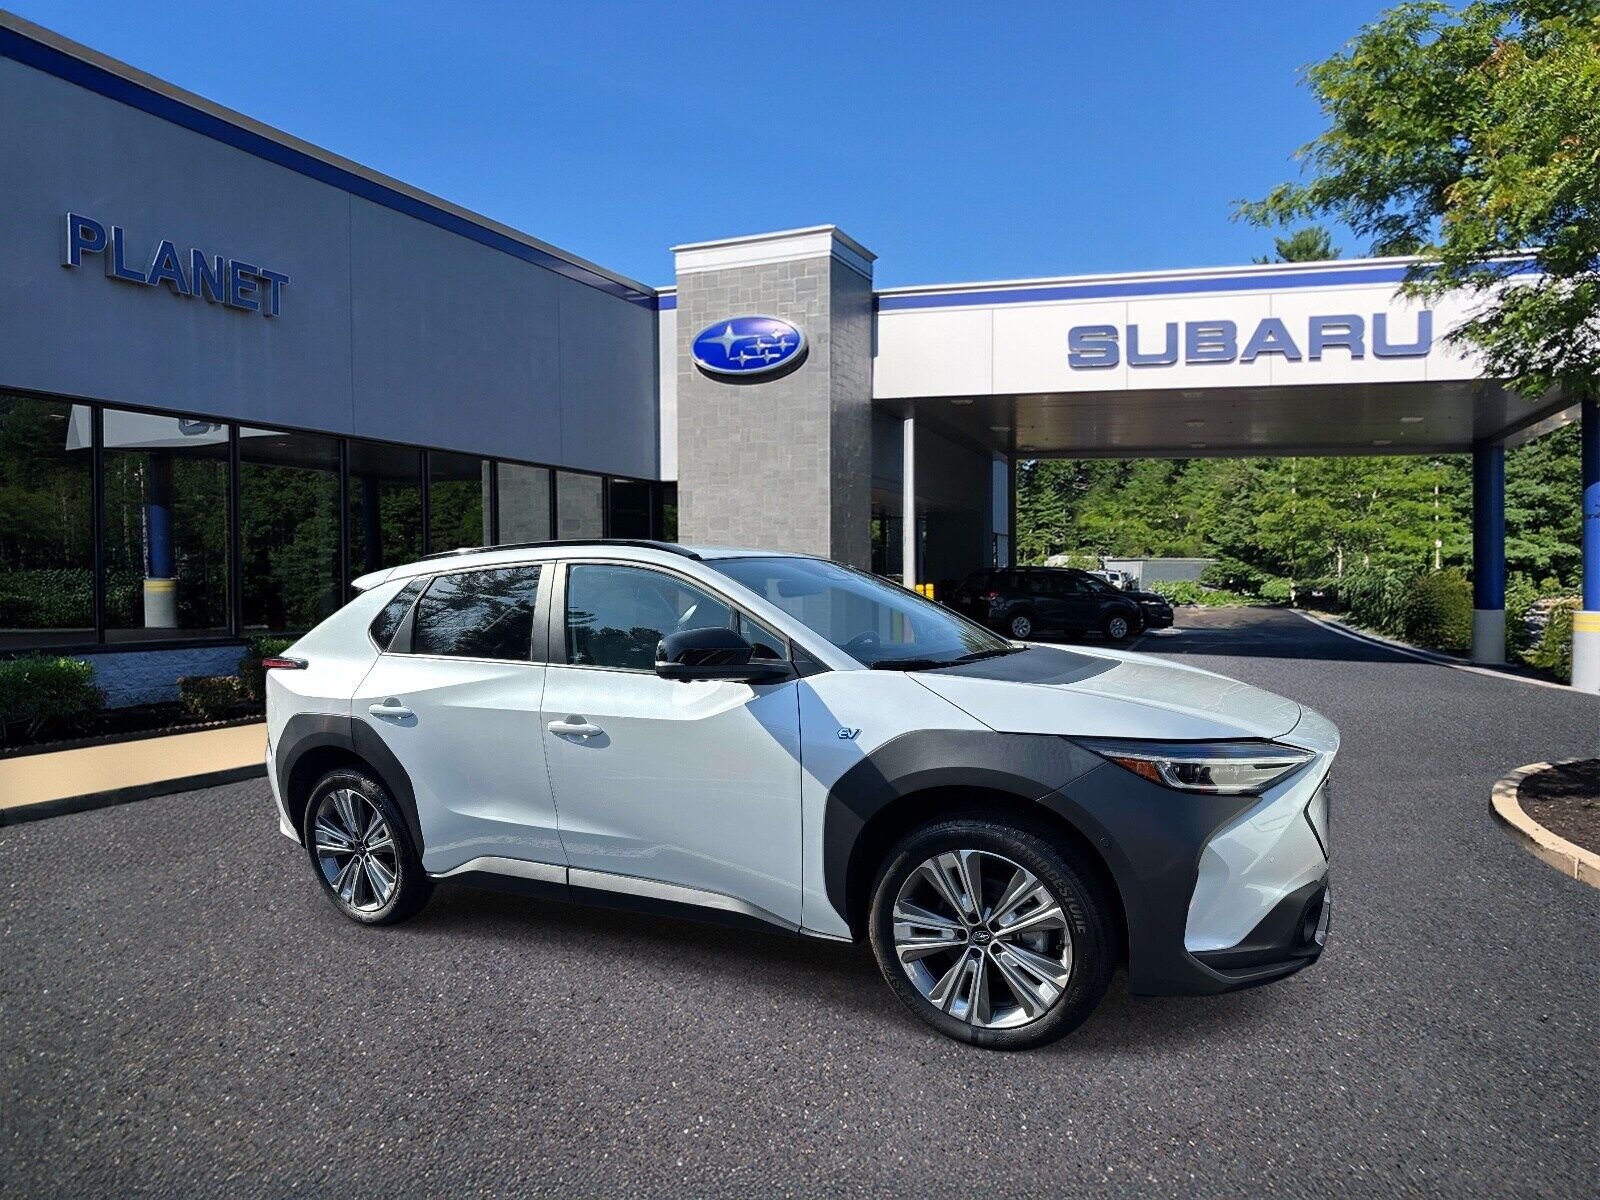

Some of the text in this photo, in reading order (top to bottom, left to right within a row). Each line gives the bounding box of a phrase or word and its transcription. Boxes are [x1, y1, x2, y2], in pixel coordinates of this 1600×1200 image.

[64, 211, 290, 317] PLANET
[1067, 309, 1433, 369] SUBARU
[836, 727, 862, 740] EV
